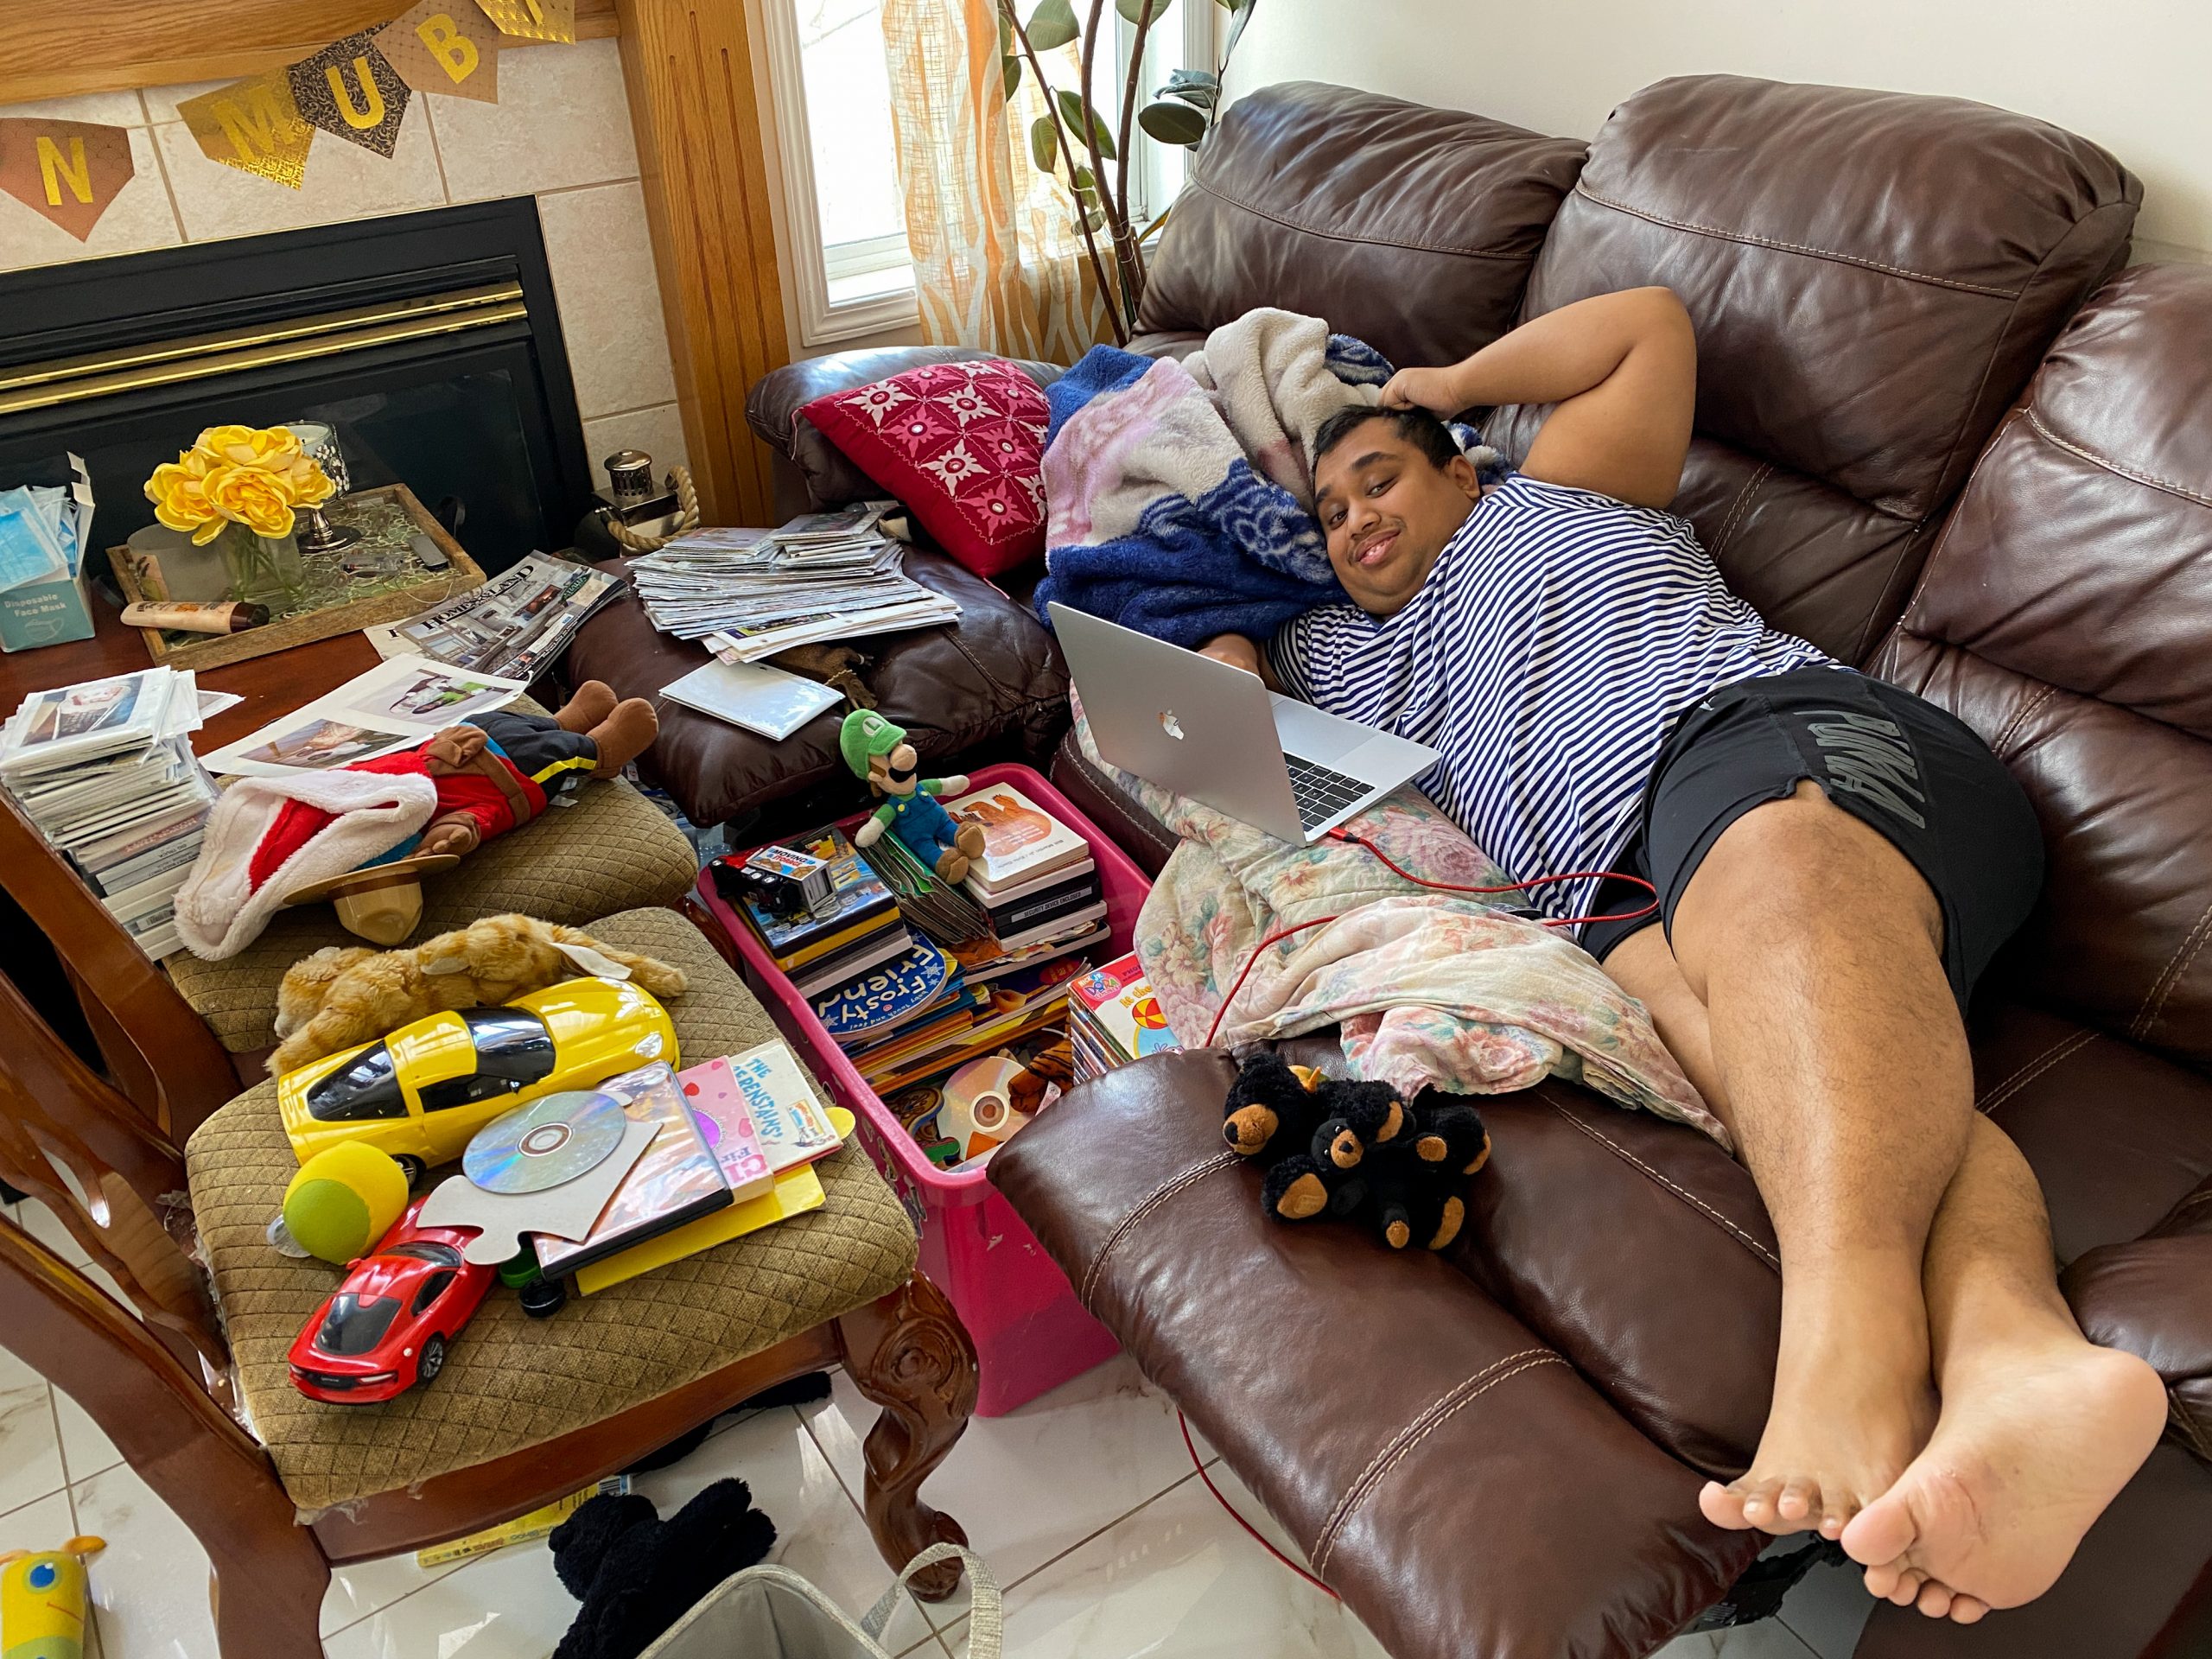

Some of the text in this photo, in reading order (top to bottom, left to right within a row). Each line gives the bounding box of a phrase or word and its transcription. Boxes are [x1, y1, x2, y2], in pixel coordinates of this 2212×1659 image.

[4, 594, 58, 608] Disposable
[14, 601, 67, 617] Face Mask
[864, 721, 881, 731] L
[1792, 709, 1926, 830] PUMA
[773, 849, 808, 863] MOVING
[1044, 899, 1060, 910] DEVICE
[1059, 892, 1082, 905] ENCLOSED
[1084, 977, 1120, 996] DORA
[842, 976, 926, 1024] Frosty
[746, 1058, 772, 1078] THE
